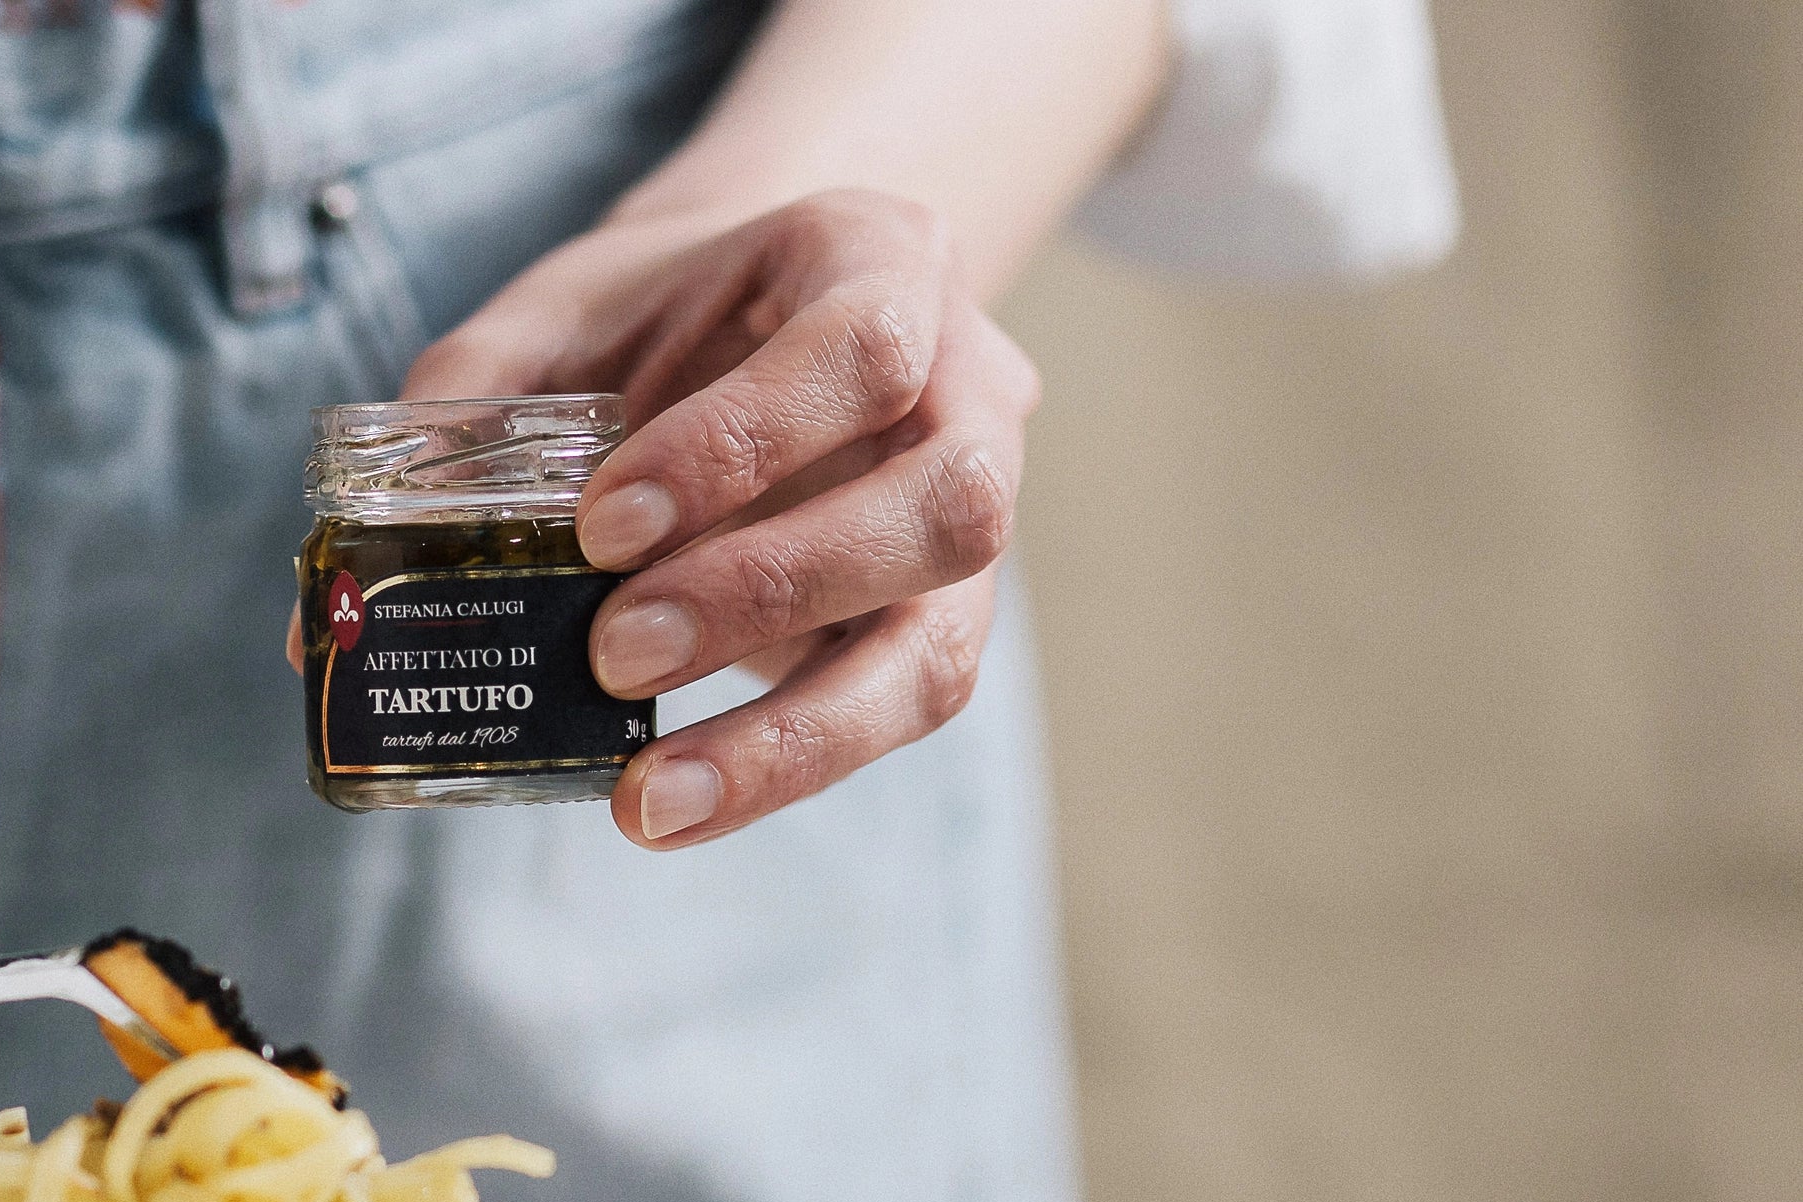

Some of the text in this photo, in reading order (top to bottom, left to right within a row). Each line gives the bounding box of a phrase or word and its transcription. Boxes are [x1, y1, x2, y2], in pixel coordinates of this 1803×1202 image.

[374, 600, 525, 619] STEFANIA CALUGI
[363, 646, 537, 672] AFFETTATO DI
[368, 684, 534, 714] TARTUFO
[382, 726, 520, 751] tartufi dal 1908
[625, 718, 640, 740] 30
